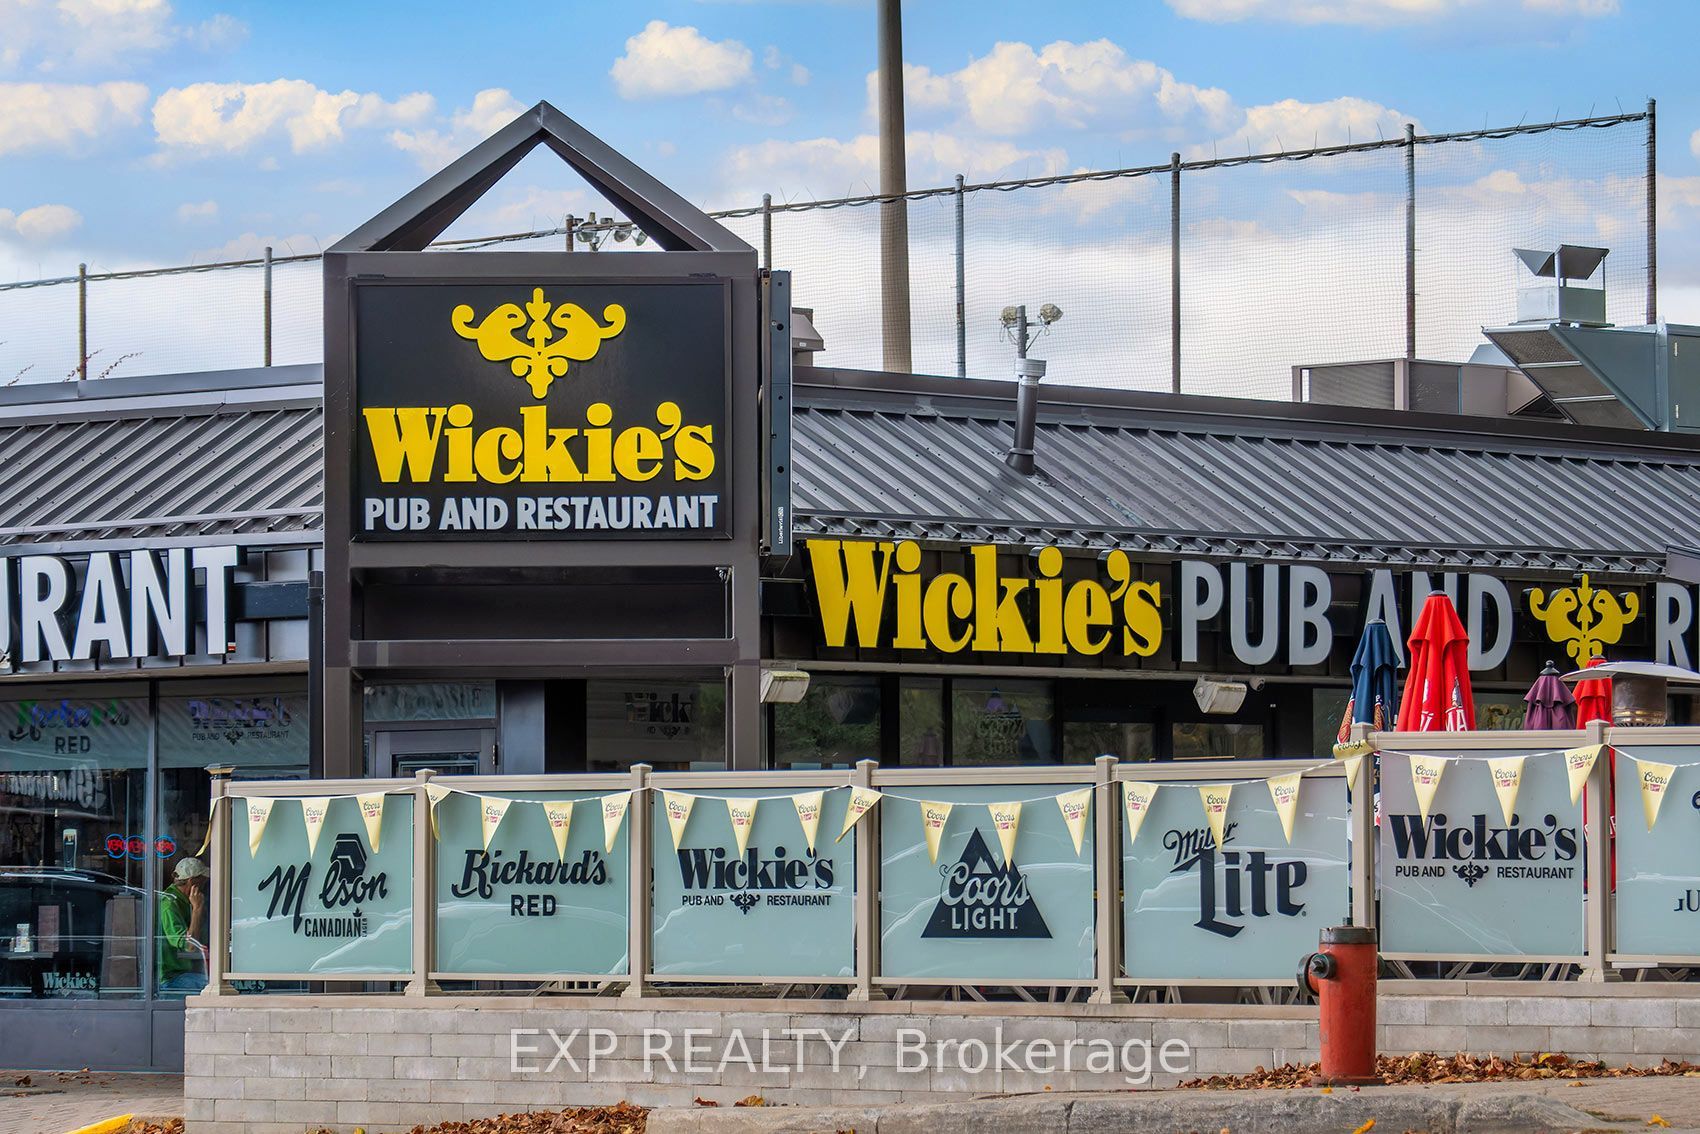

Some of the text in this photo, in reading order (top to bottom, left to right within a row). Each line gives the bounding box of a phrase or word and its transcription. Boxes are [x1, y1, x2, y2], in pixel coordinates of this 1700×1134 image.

[363, 401, 715, 484] Wickie's
[365, 495, 718, 531] PUB AND RESTAURANT
[0, 545, 238, 662] RANT
[805, 538, 1163, 657] Wickie's
[1181, 560, 1333, 666] PUB
[55, 736, 91, 754] RED
[1570, 753, 1593, 764] Coors
[1415, 765, 1438, 776] Coors
[1494, 769, 1517, 780] Coors
[1644, 771, 1667, 784] Coors
[1127, 791, 1148, 803] Coors
[1274, 786, 1295, 797] Coors
[668, 800, 687, 812] Coors
[1206, 794, 1227, 805] Coors
[732, 808, 750, 818] Coors
[798, 804, 818, 814] Coors
[926, 809, 946, 821] Coors
[1063, 802, 1084, 813] Coors
[994, 812, 1015, 822] Coors
[1388, 813, 1577, 860] Wickie's
[451, 850, 607, 899] Rickard's
[677, 846, 834, 890] Wickie's
[1395, 865, 1573, 879] PUB AND RESTAURANT
[939, 862, 1031, 906] Coors
[258, 860, 387, 934] Mlson
[682, 895, 831, 906] PUB AND RESTAURANT
[1194, 849, 1308, 938] Lite
[511, 894, 556, 916] RED
[951, 908, 1018, 930] LIGHT
[304, 918, 361, 937] CANADIAN
[42, 972, 96, 989] Wickie's
